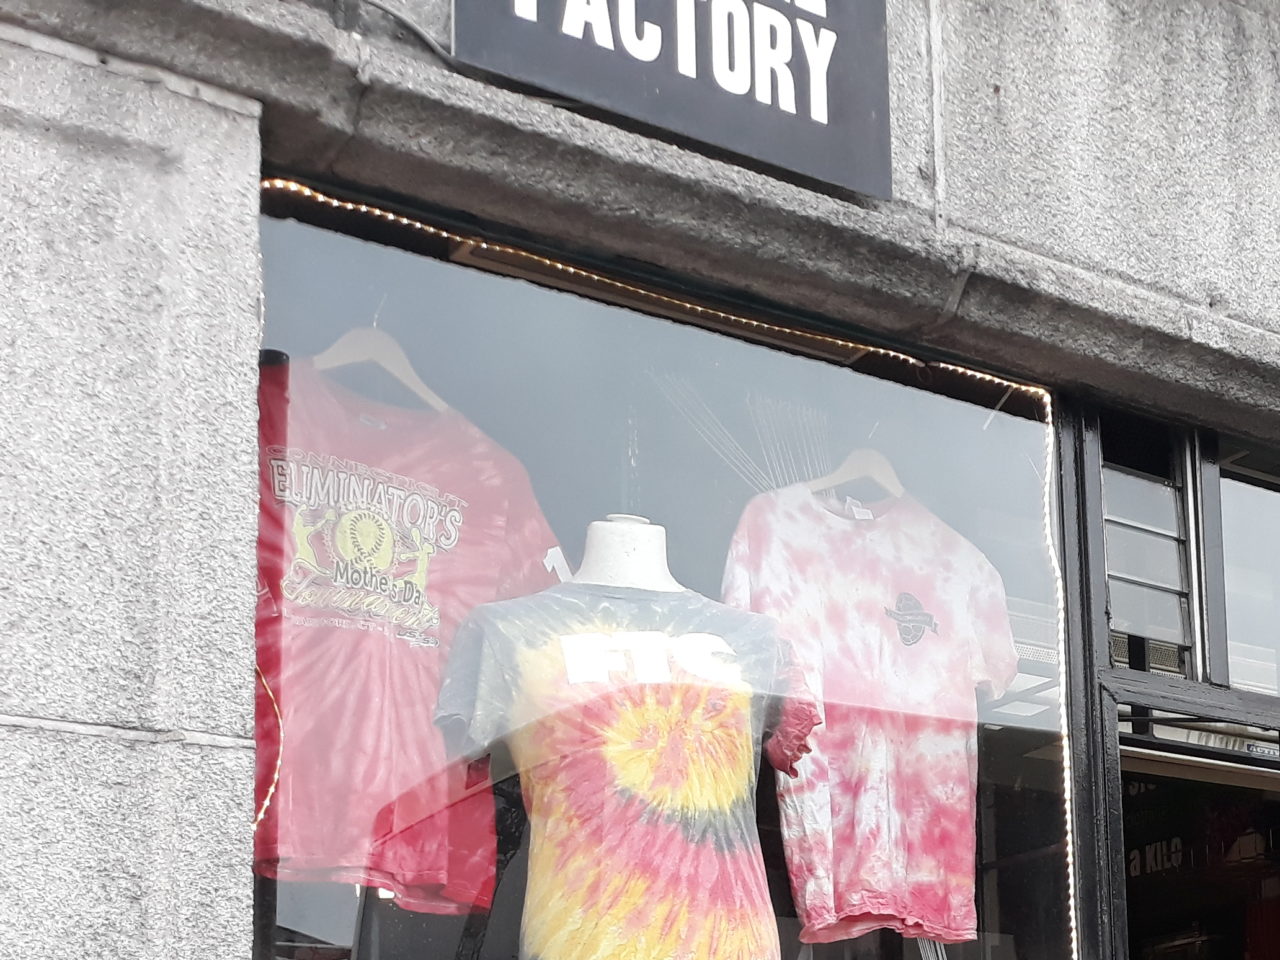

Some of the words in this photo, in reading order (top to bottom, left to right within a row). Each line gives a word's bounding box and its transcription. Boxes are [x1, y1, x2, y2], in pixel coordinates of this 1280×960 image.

[513, 0, 838, 125] ACTORY
[269, 458, 464, 548] ELIMINATOR'S
[1145, 837, 1183, 873] KILO
